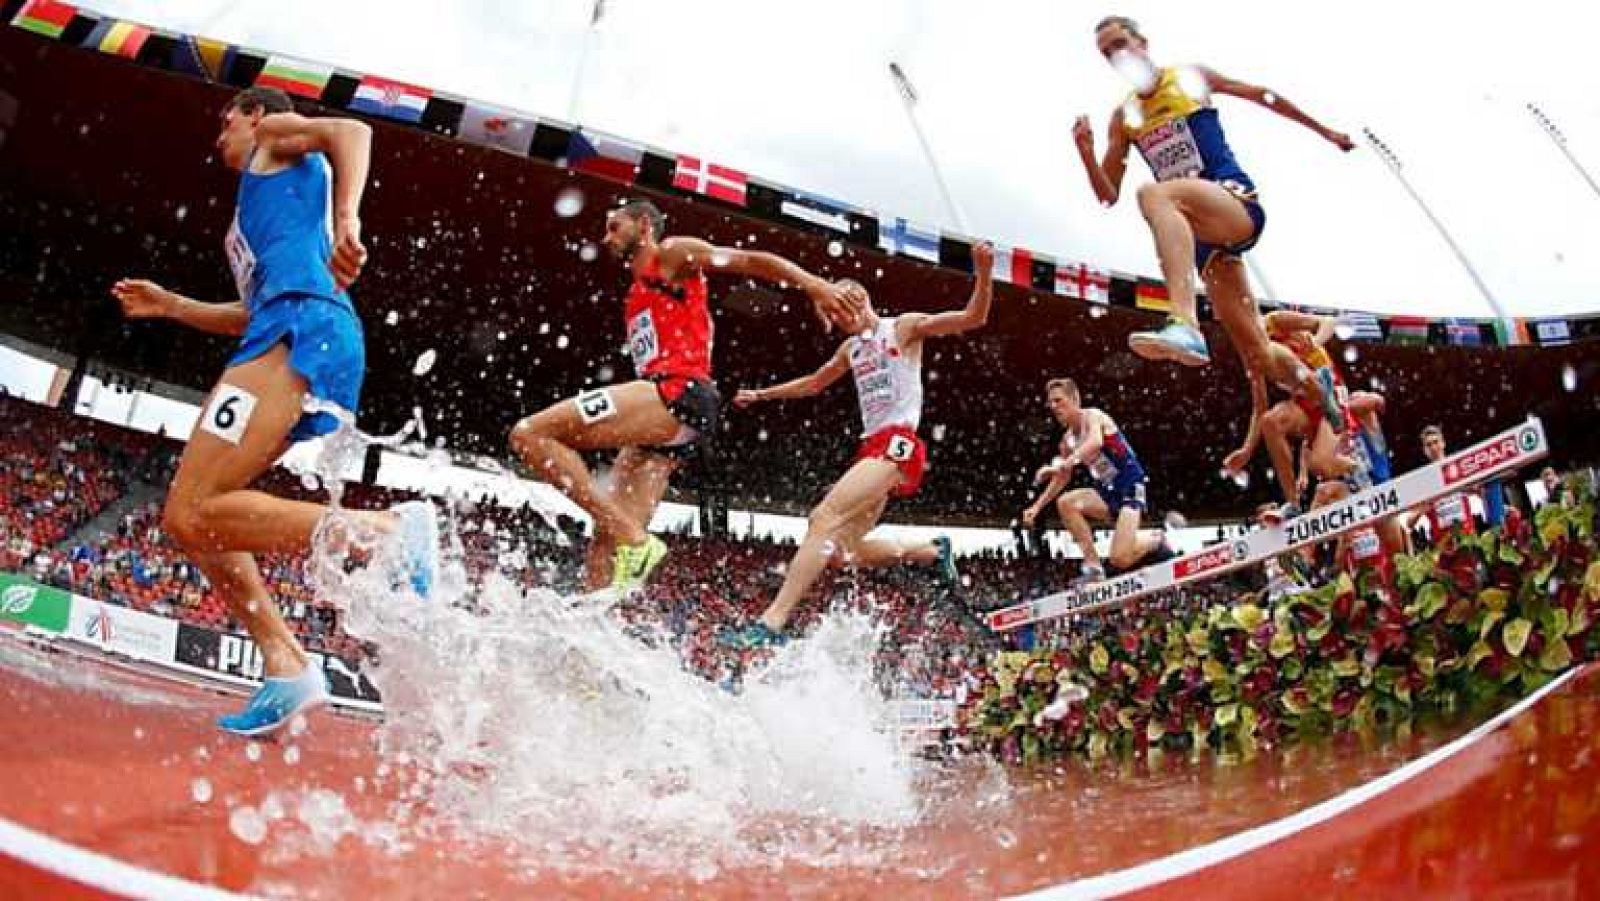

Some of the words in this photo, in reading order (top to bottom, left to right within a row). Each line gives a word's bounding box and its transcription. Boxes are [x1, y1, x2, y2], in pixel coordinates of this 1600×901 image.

[214, 396, 241, 429] 6
[580, 391, 609, 417] 13
[893, 440, 908, 458] 5
[1459, 436, 1517, 476] SPAR
